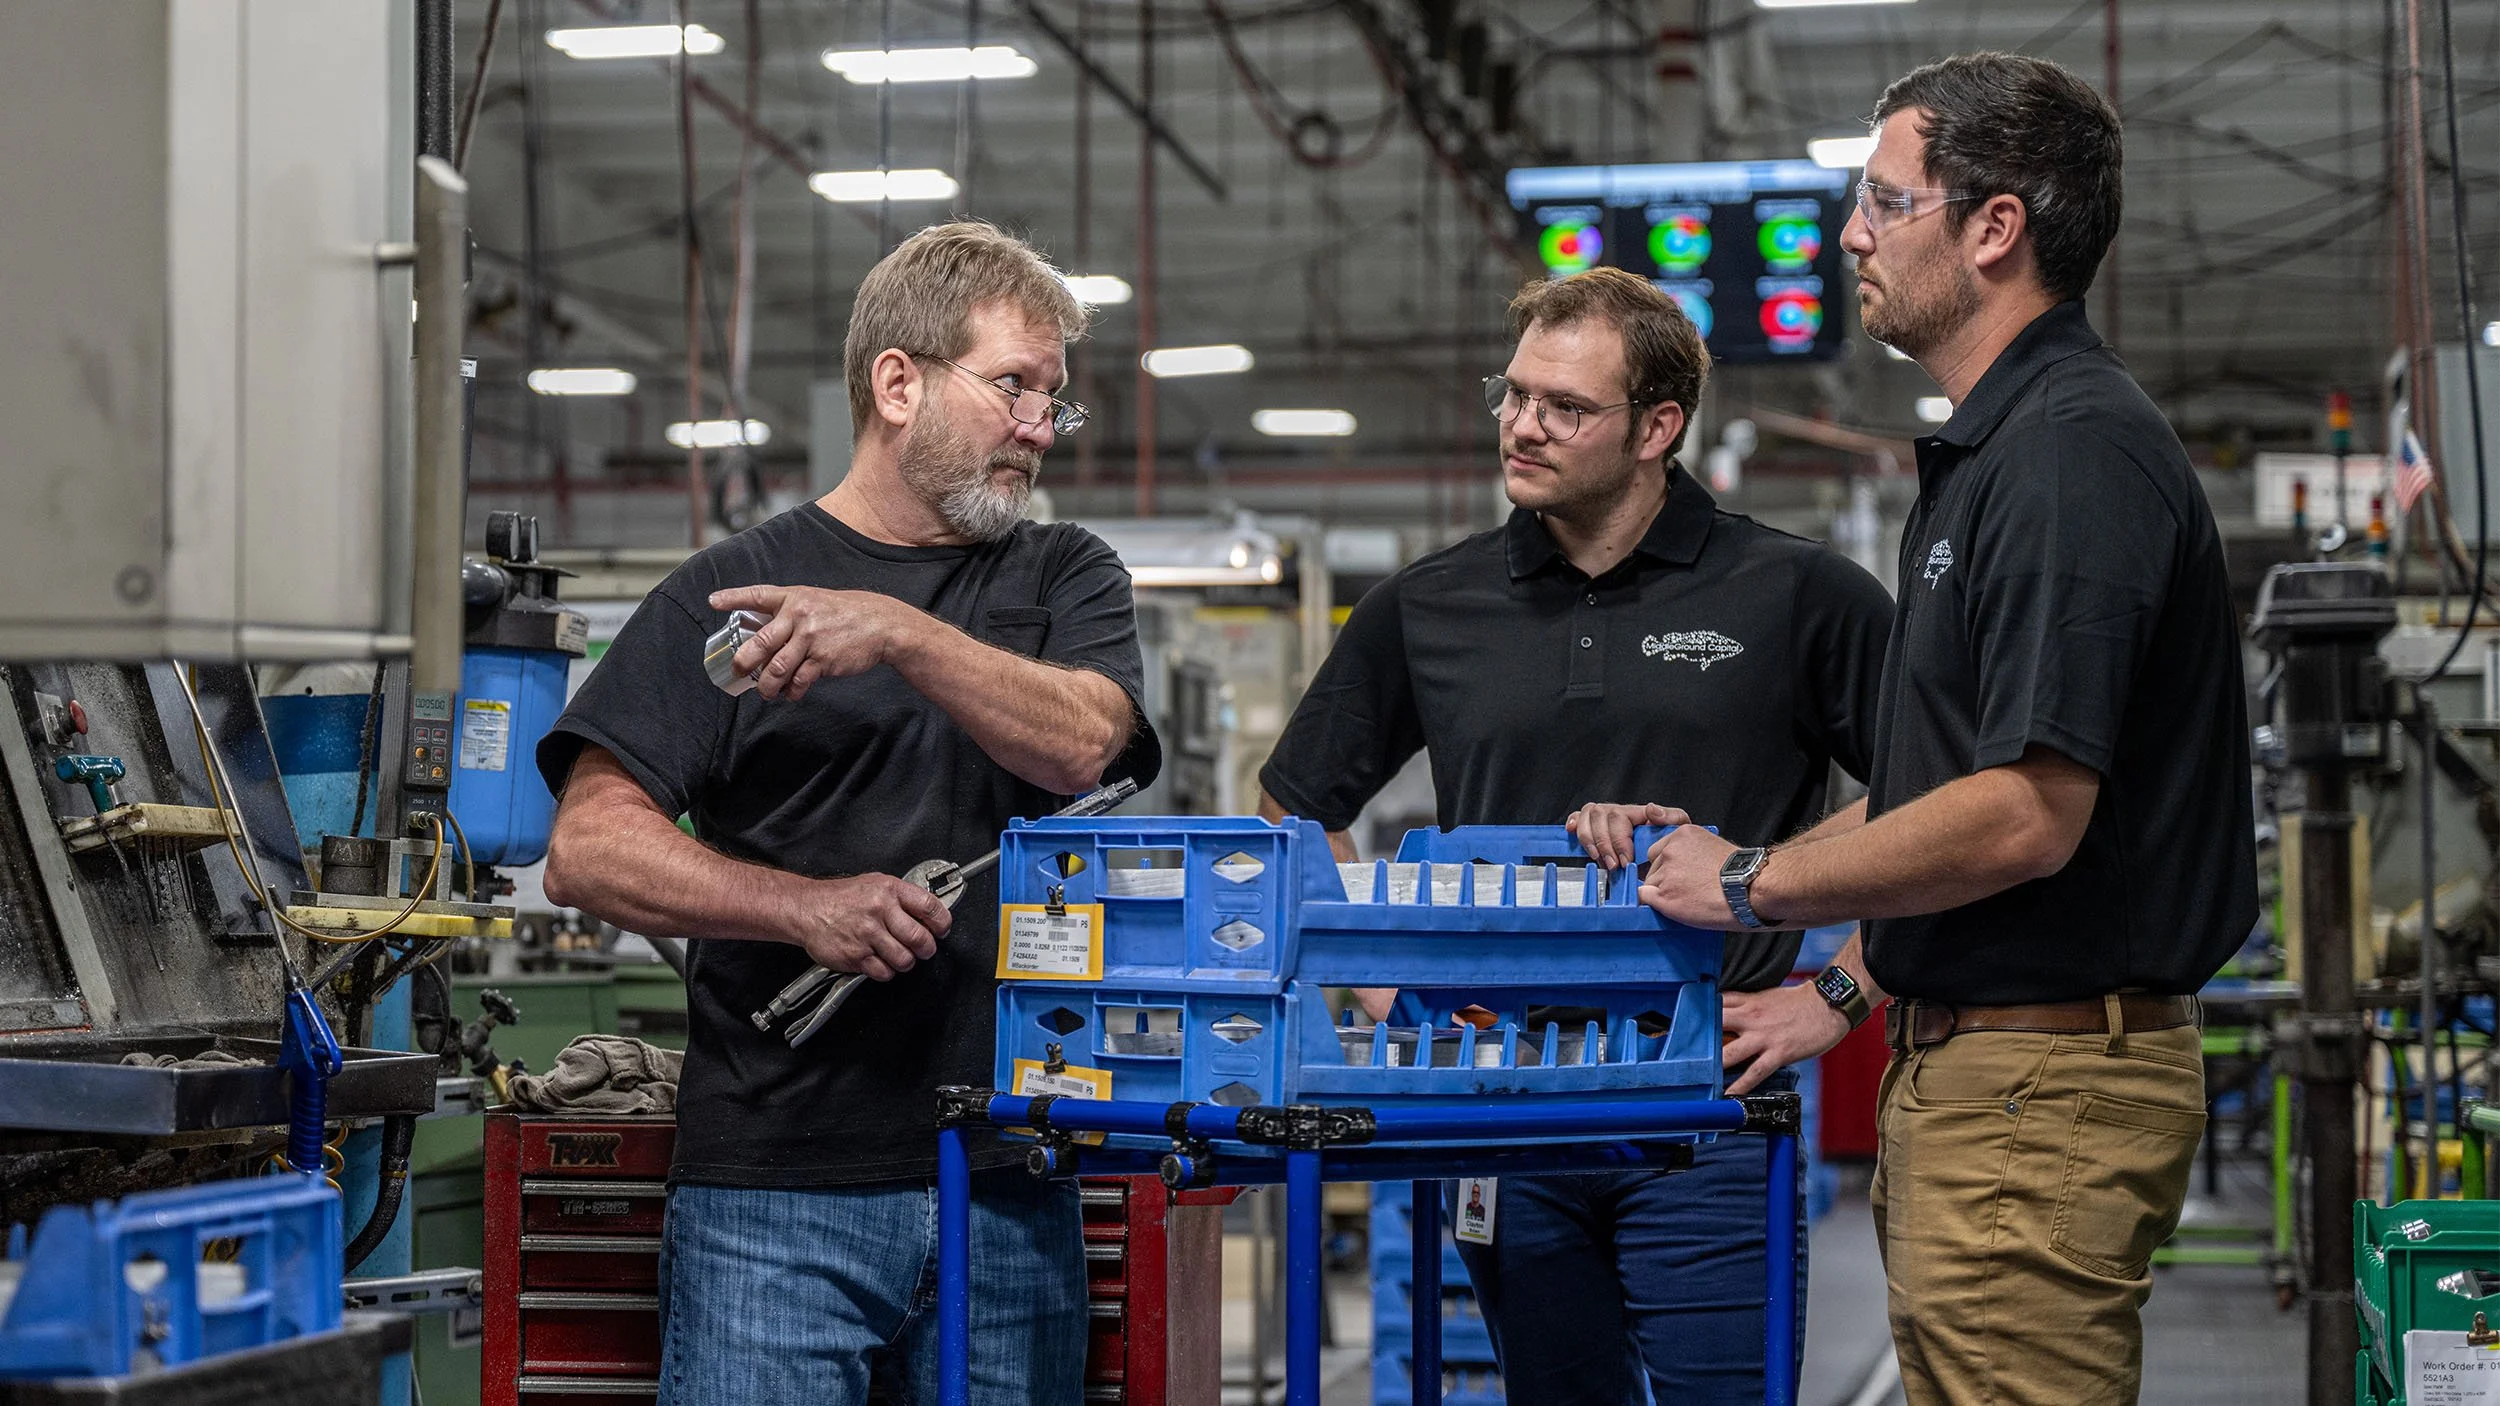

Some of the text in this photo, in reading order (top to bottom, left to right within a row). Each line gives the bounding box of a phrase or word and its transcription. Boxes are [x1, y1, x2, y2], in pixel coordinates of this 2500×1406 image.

[1646, 643, 1739, 652] MiddleGround Capital
[2423, 1361, 2446, 1370] Work
[2449, 1361, 2475, 1370] Order
[2423, 1374, 2454, 1382] 5521A3
